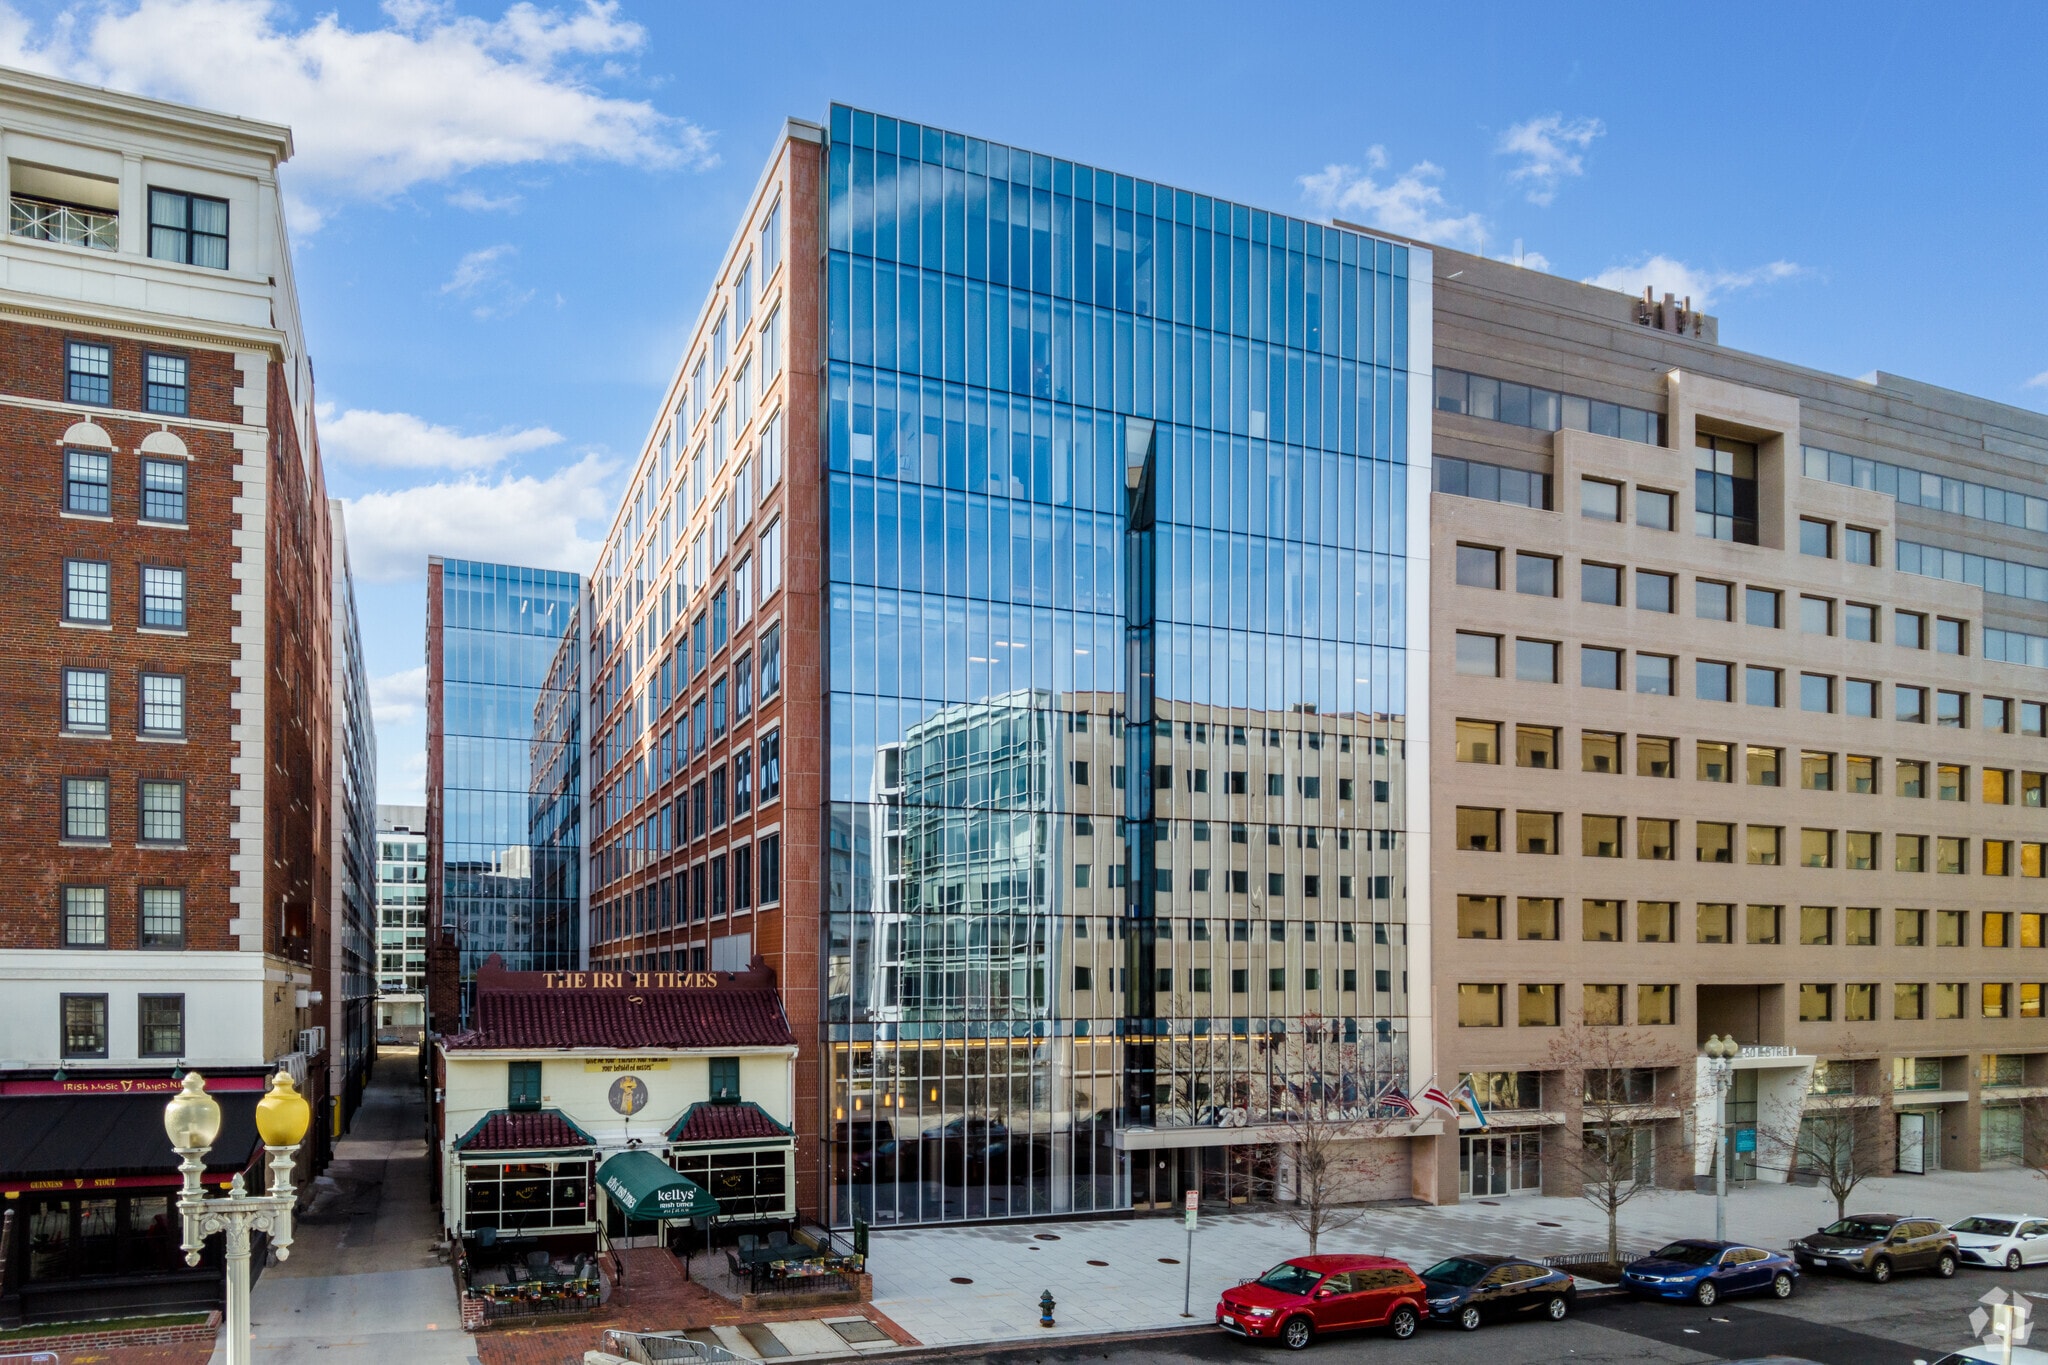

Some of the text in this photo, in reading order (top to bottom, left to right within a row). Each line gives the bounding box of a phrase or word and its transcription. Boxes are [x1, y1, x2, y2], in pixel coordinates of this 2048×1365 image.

[543, 972, 718, 989] THE IRIH TIMES
[30, 1180, 63, 1189] GUINNESS
[94, 1178, 116, 1187] STOUT
